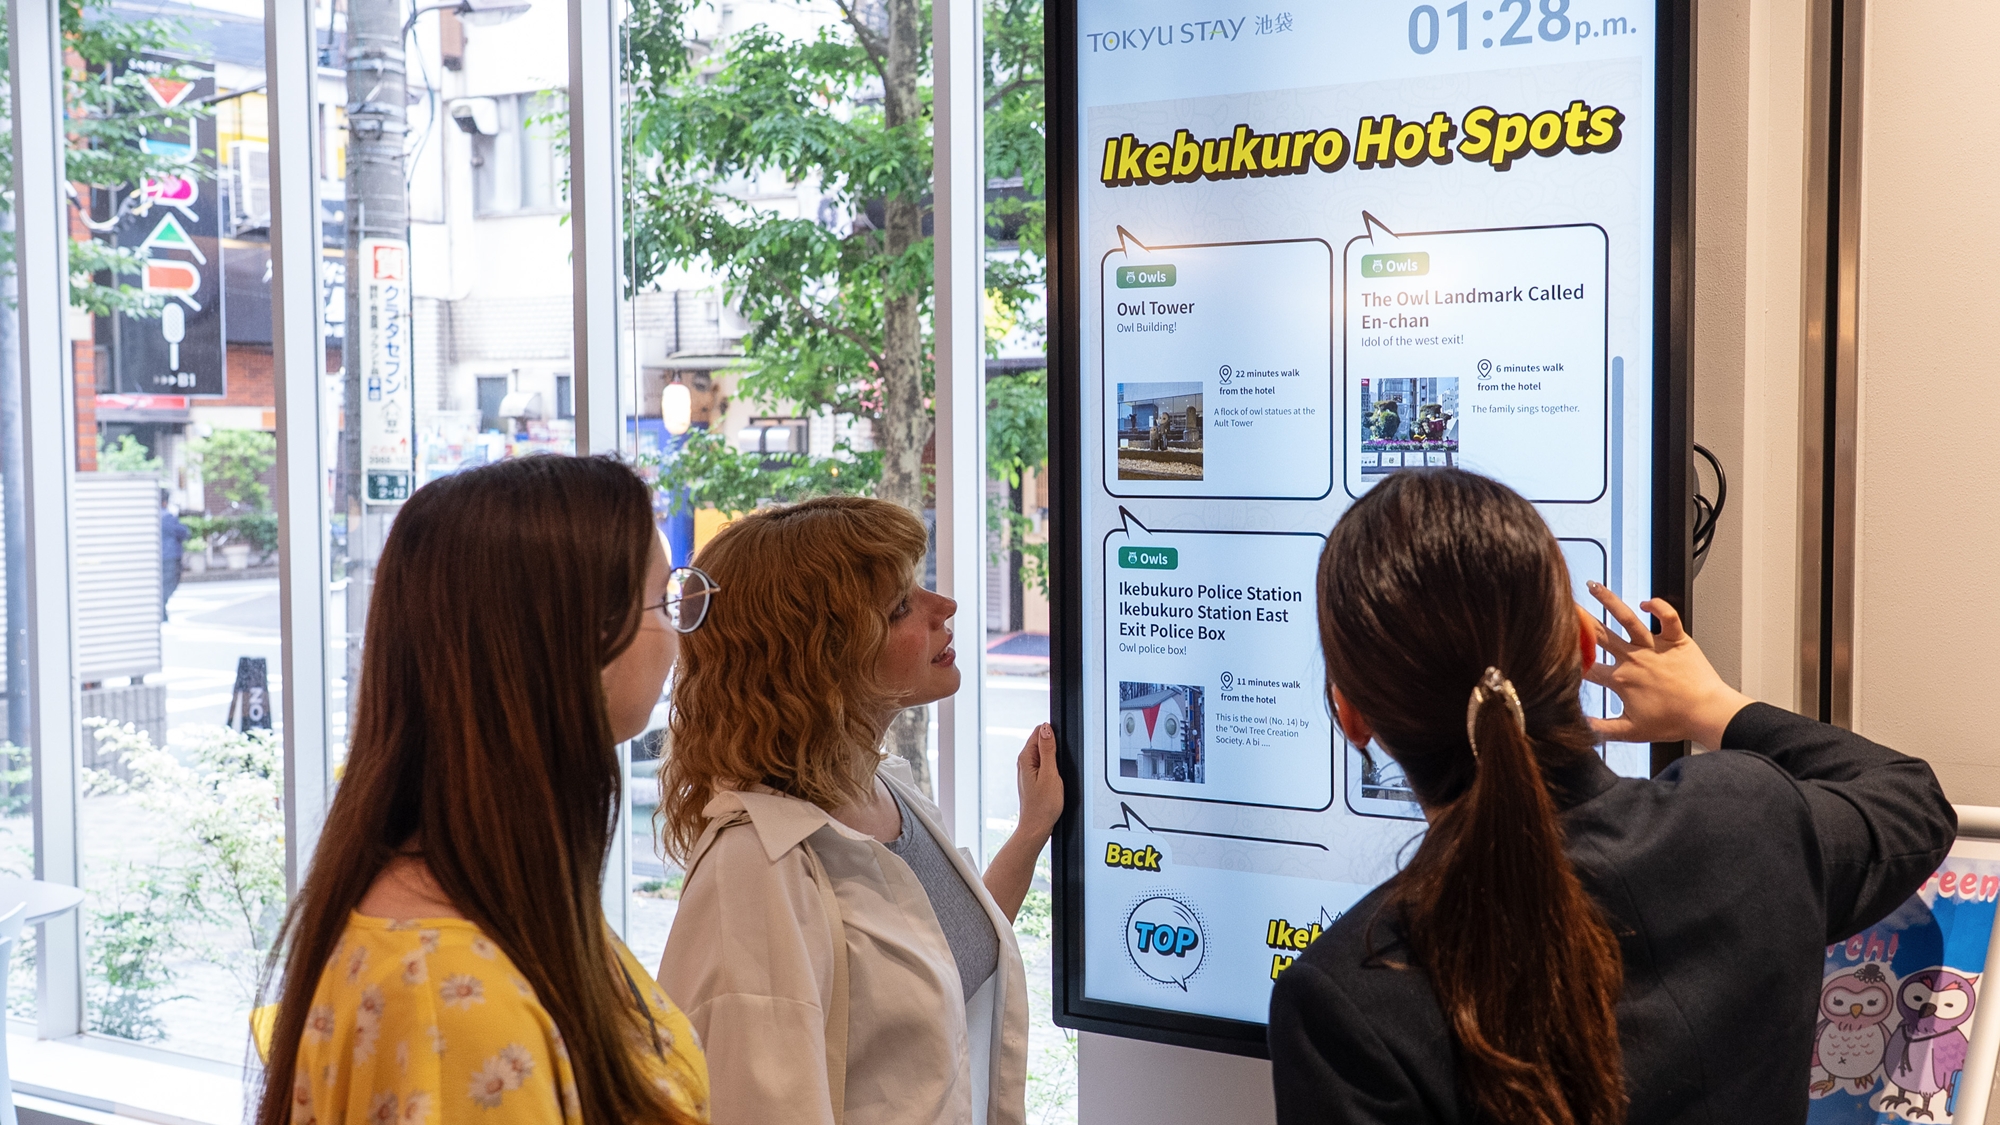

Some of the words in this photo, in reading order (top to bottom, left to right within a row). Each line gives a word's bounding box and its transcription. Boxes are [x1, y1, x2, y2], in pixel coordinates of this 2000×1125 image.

[1087, 23, 1174, 53] TOKYU
[1180, 16, 1246, 44] STAY
[1254, 12, 1294, 36] 池袋
[1407, 0, 1571, 55] 01:28
[1575, 19, 1637, 45] p.m.
[1101, 123, 1347, 187] Ikebukuro
[1353, 114, 1457, 169] Hot
[1458, 99, 1626, 171] Spots
[1386, 259, 1418, 272] Owls
[1138, 271, 1167, 284] Owls
[1362, 292, 1391, 307] The
[1397, 290, 1429, 306] Owl
[1435, 287, 1522, 304] Landmark
[1528, 284, 1584, 301] Called
[1117, 302, 1145, 316] Owl
[1149, 301, 1195, 315] Tower
[1117, 323, 1134, 333] Owl
[1137, 322, 1177, 333] Building!
[1362, 314, 1429, 329] En-chan
[1361, 336, 1380, 347] Idol
[1383, 336, 1393, 346] of
[1396, 336, 1412, 346] the
[1415, 336, 1439, 346] west
[1442, 335, 1464, 345] exit!
[1235, 370, 1245, 378] 22
[1247, 369, 1279, 378] minutes
[1281, 369, 1300, 377] walk
[1496, 364, 1501, 372] 6
[1503, 364, 1540, 372] minutes
[1542, 363, 1564, 372] walk
[1219, 387, 1238, 395] from
[1477, 383, 1499, 391] from
[1501, 383, 1515, 391] the
[1518, 382, 1541, 390] hotel
[1220, 407, 1239, 416] flock
[1240, 407, 1249, 415] of
[1250, 407, 1263, 415] owl
[1302, 407, 1315, 415] the
[1472, 405, 1487, 413] The
[1489, 404, 1515, 415] family
[1517, 405, 1539, 415] sings
[1541, 404, 1580, 415] together.
[1214, 419, 1229, 427] Ault
[1231, 419, 1254, 427] Tower
[1140, 553, 1168, 565] Owls
[1119, 582, 1193, 598] Ikebukuro
[1198, 585, 1242, 600] Police
[1247, 586, 1302, 602] Station
[1119, 602, 1193, 618] Ikebukuro
[1197, 605, 1251, 621] Station
[1256, 608, 1288, 623] East
[1119, 622, 1146, 637] Exit
[1150, 624, 1194, 639] Police
[1198, 626, 1226, 641] Box
[1119, 642, 1136, 653] Owl
[1138, 644, 1166, 655] police
[1167, 645, 1187, 655] box!
[1237, 678, 1246, 686] 11
[1248, 678, 1280, 688] minutes
[1282, 680, 1300, 688] walk
[1221, 694, 1240, 702] from
[1242, 695, 1254, 703] the
[1256, 696, 1276, 704] hotel
[1216, 713, 1232, 722] This
[1234, 714, 1238, 722] is
[1240, 715, 1252, 723] the
[1254, 715, 1268, 724] owl
[1269, 716, 1284, 726] (No.
[1286, 718, 1298, 727] 14)
[1300, 719, 1309, 728] by
[1216, 725, 1228, 733] the
[1230, 726, 1248, 734] "Owl
[1250, 727, 1265, 736] Tree
[1267, 728, 1299, 737] Creation
[1216, 736, 1244, 746] Society.
[1246, 737, 1252, 746] A
[1254, 738, 1260, 746] bi
[1105, 842, 1162, 872] Back
[1135, 921, 1198, 957] TOP
